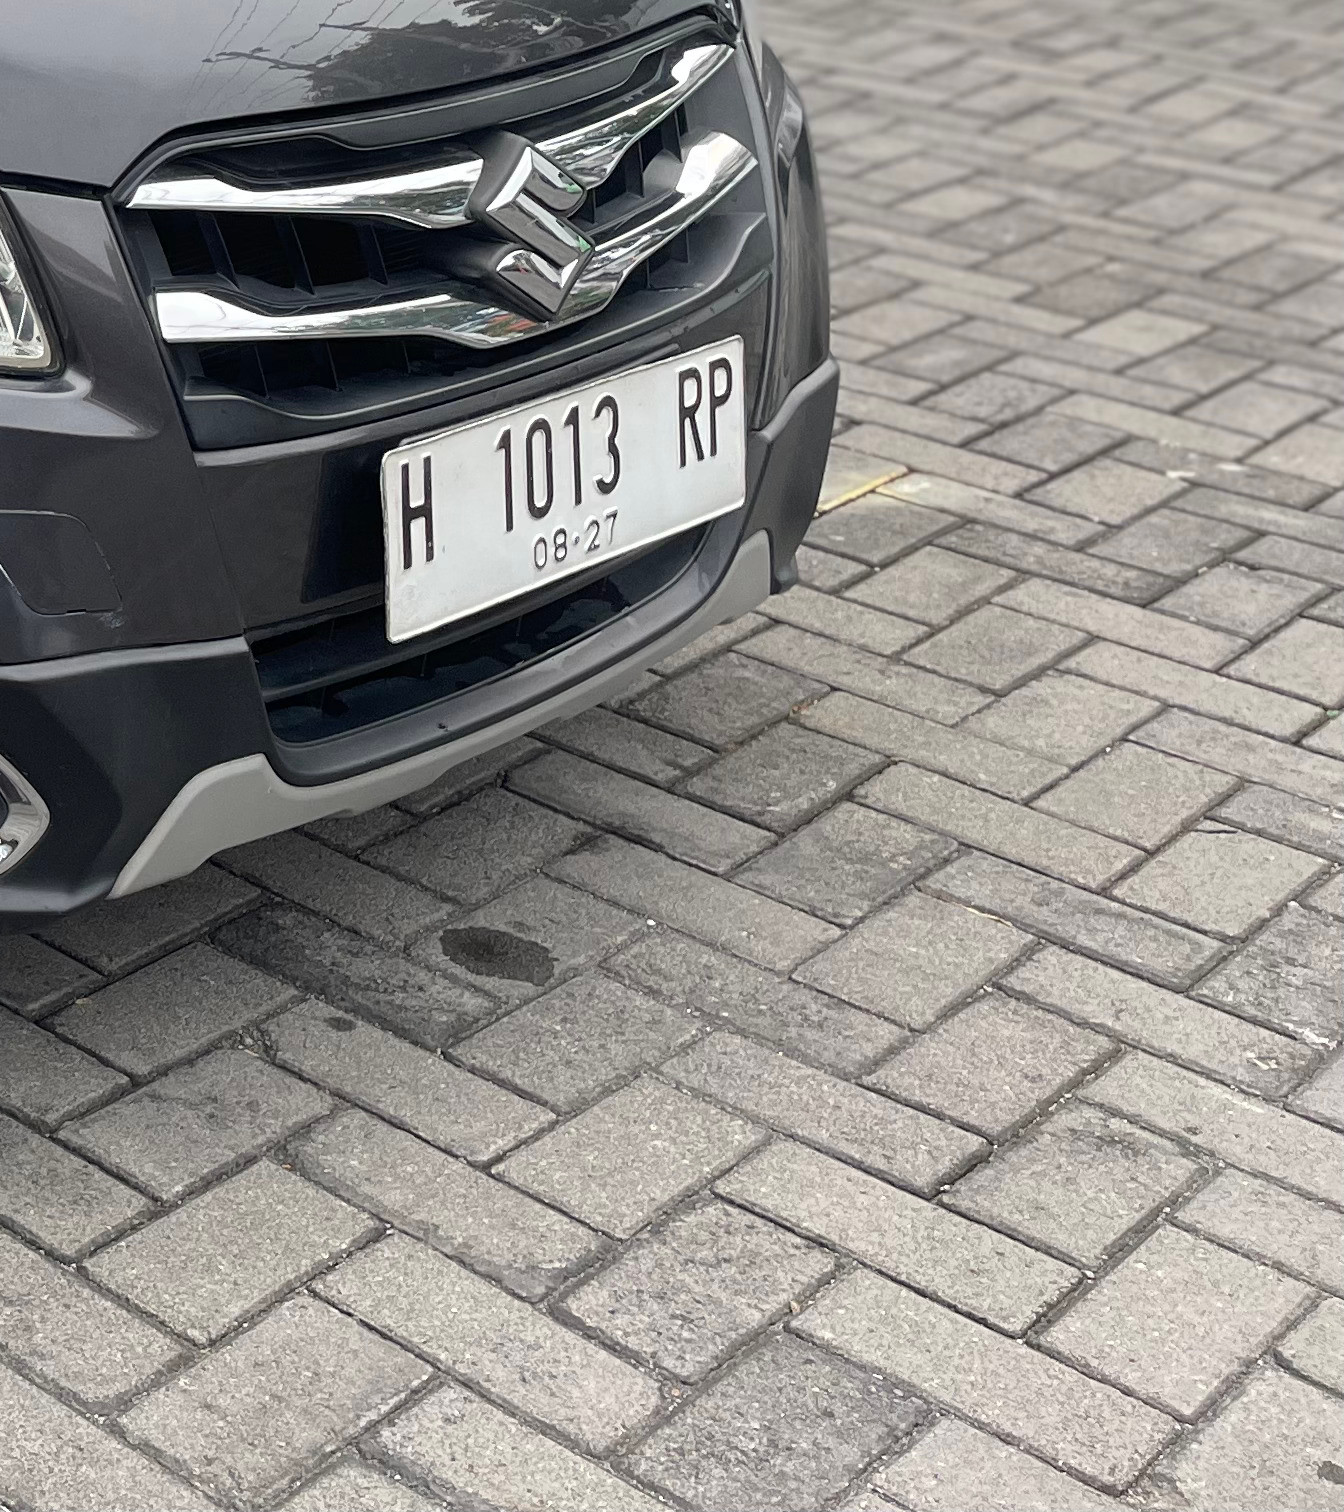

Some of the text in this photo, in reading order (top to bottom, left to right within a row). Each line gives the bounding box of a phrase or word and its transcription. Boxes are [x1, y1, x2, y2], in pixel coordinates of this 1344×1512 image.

[399, 355, 733, 570] H 1013 RP
